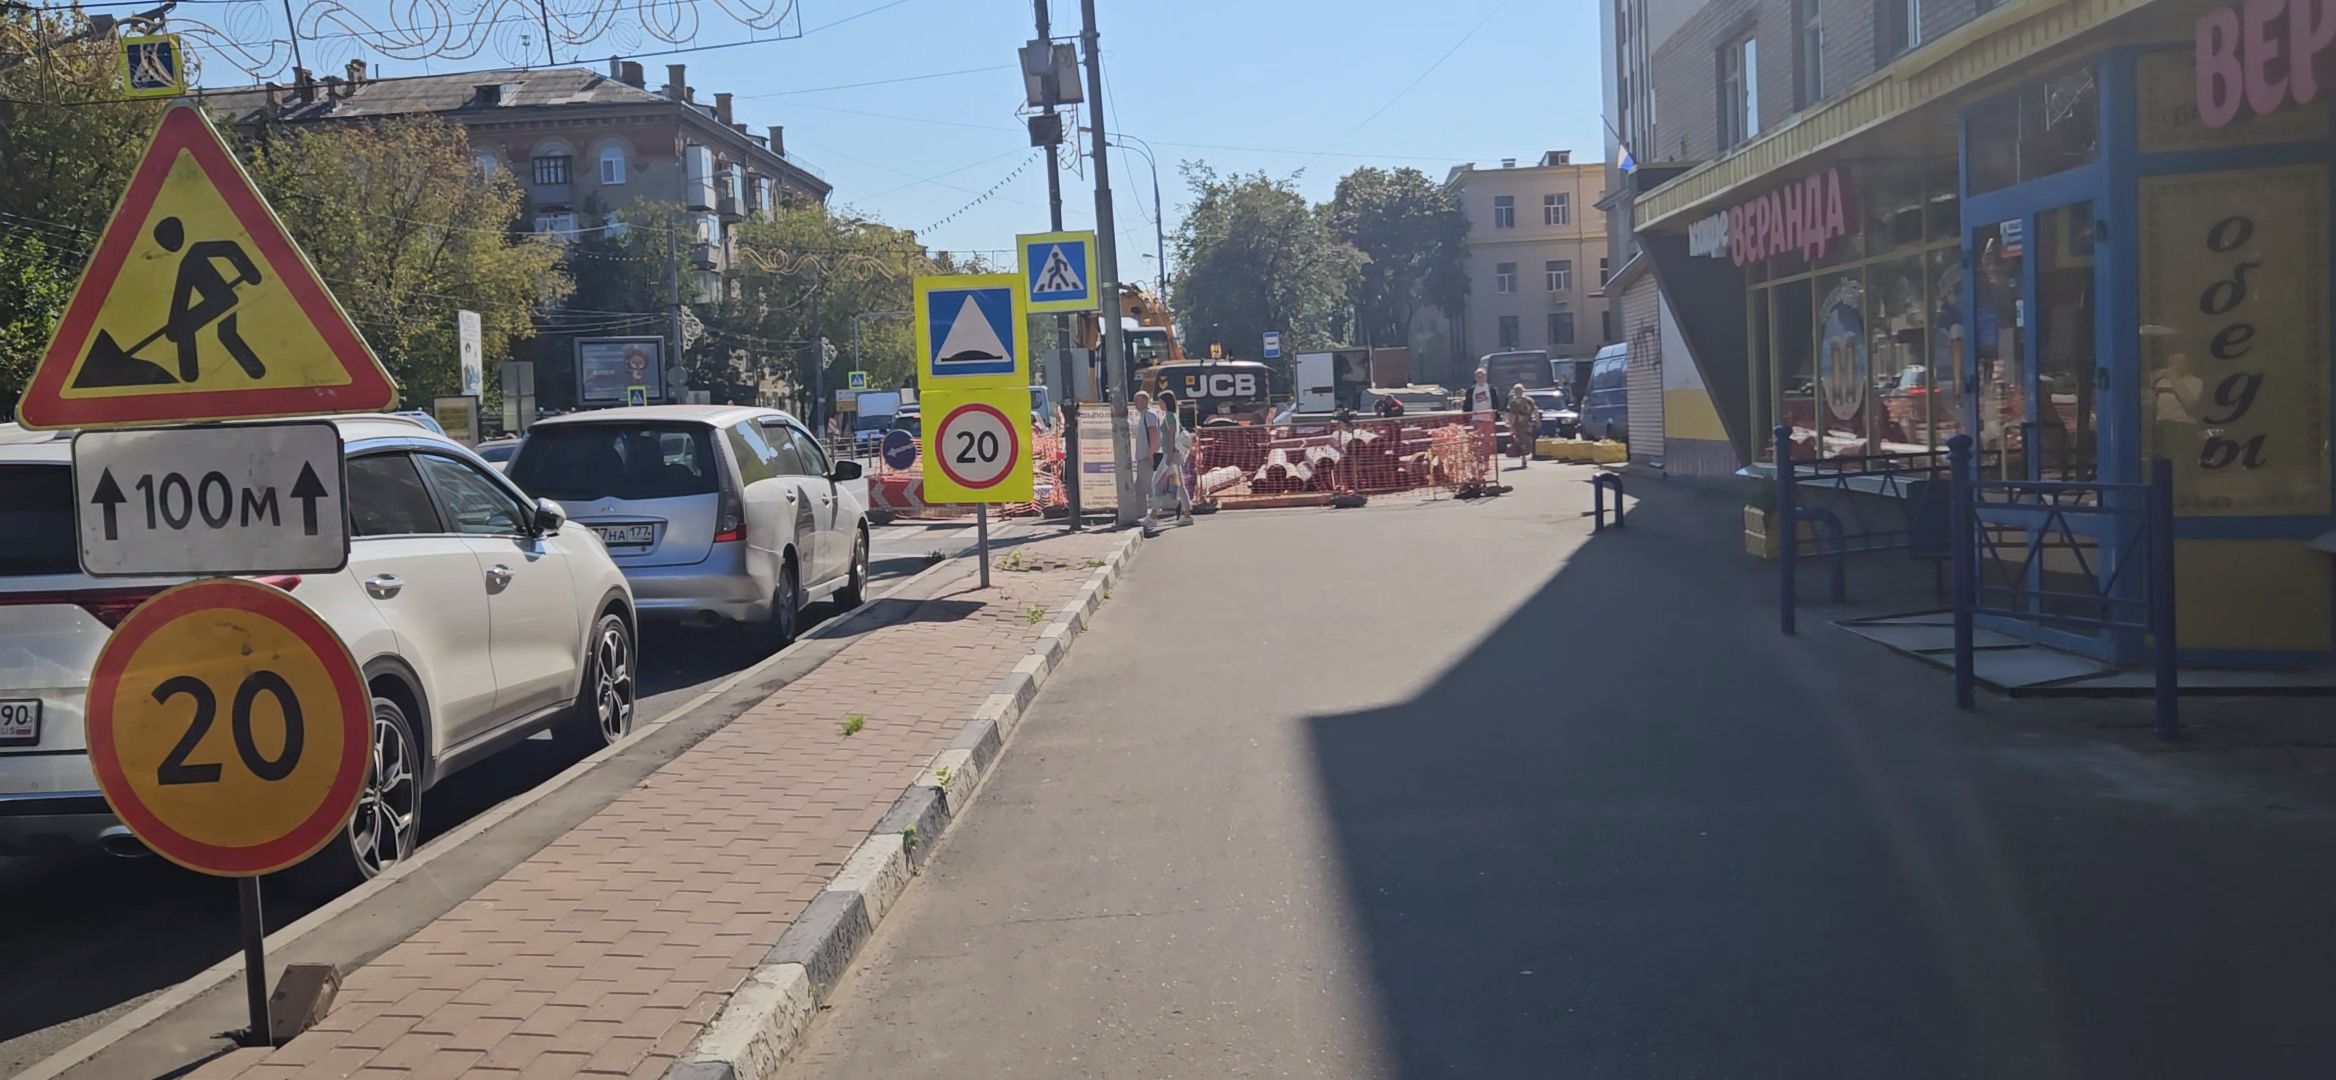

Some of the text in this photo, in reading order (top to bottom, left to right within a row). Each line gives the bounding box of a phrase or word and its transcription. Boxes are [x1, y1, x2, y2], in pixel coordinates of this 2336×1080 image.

[2196, 0, 2336, 128] ВЕР
[1730, 168, 1845, 267] ВЕРАНДА
[1185, 374, 1256, 399] JCB
[956, 431, 999, 464] 20
[1, 704, 28, 726] 90
[151, 669, 305, 786] 20
